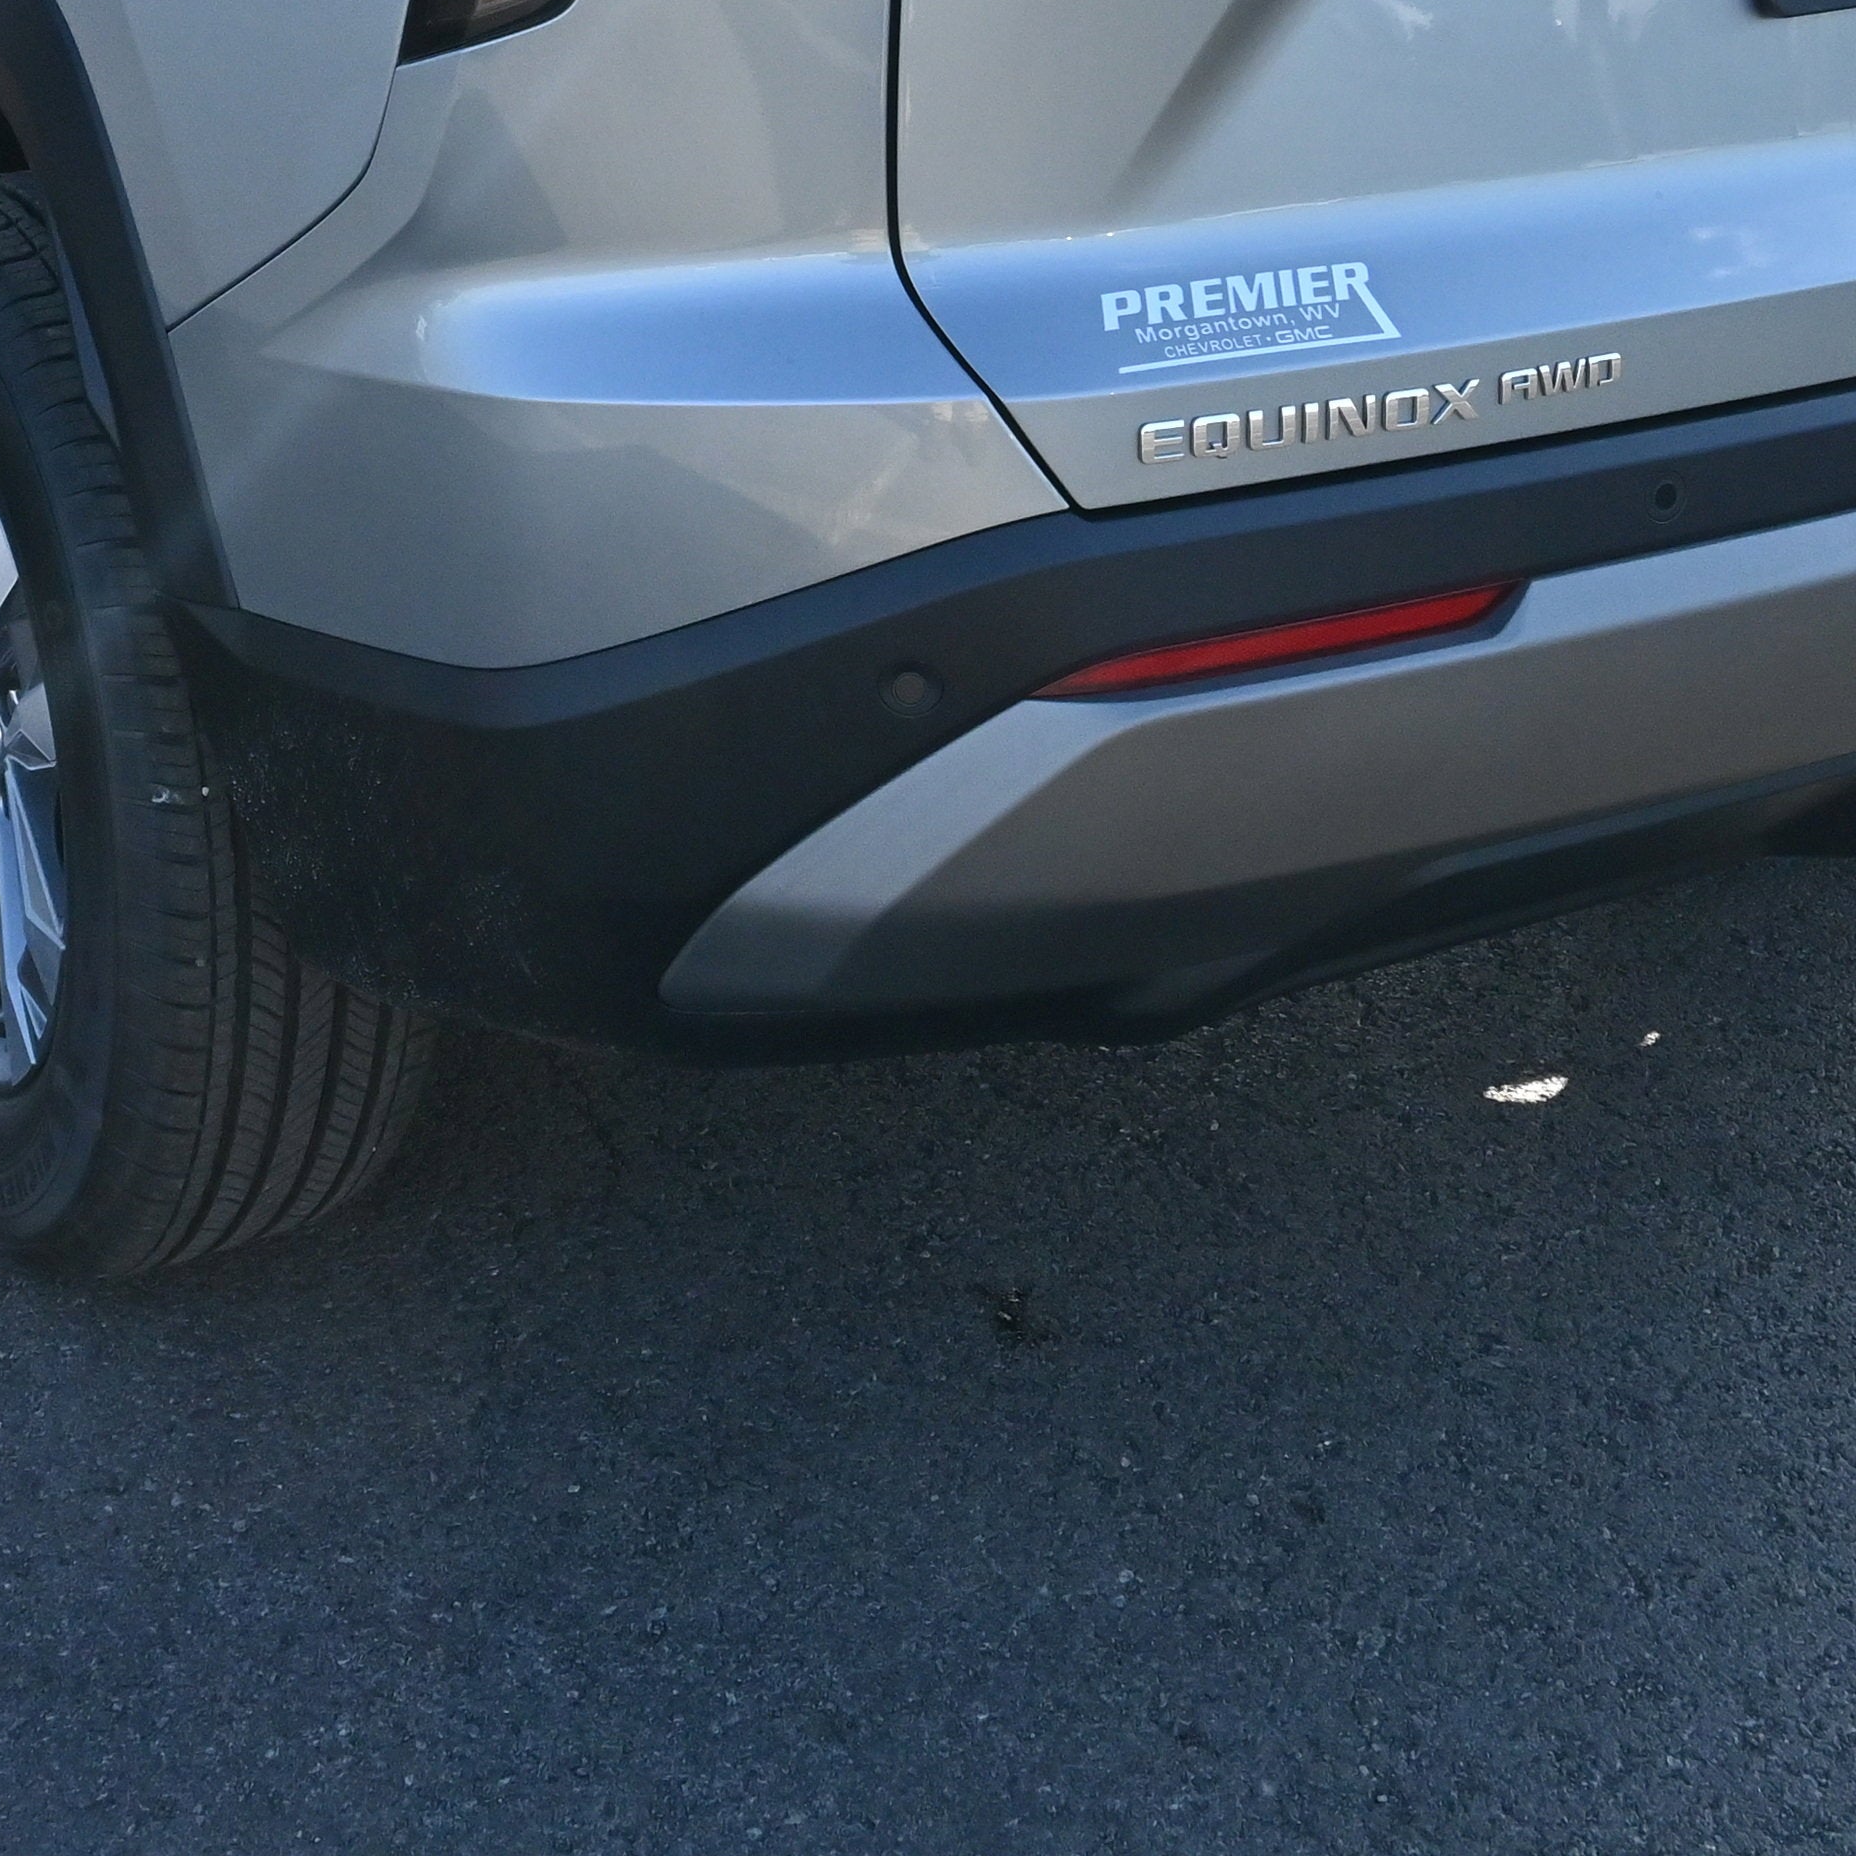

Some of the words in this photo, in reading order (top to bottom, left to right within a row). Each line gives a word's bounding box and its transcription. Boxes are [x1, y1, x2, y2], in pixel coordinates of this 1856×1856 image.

[1101, 261, 1372, 332] PREMIER
[1134, 312, 1296, 344] Morgantown,
[1299, 303, 1341, 322] WV
[1164, 334, 1262, 359] CHEVROLET
[1276, 325, 1334, 344] GMC
[1137, 378, 1481, 465] EQUINOX
[1498, 352, 1622, 405] AWD
